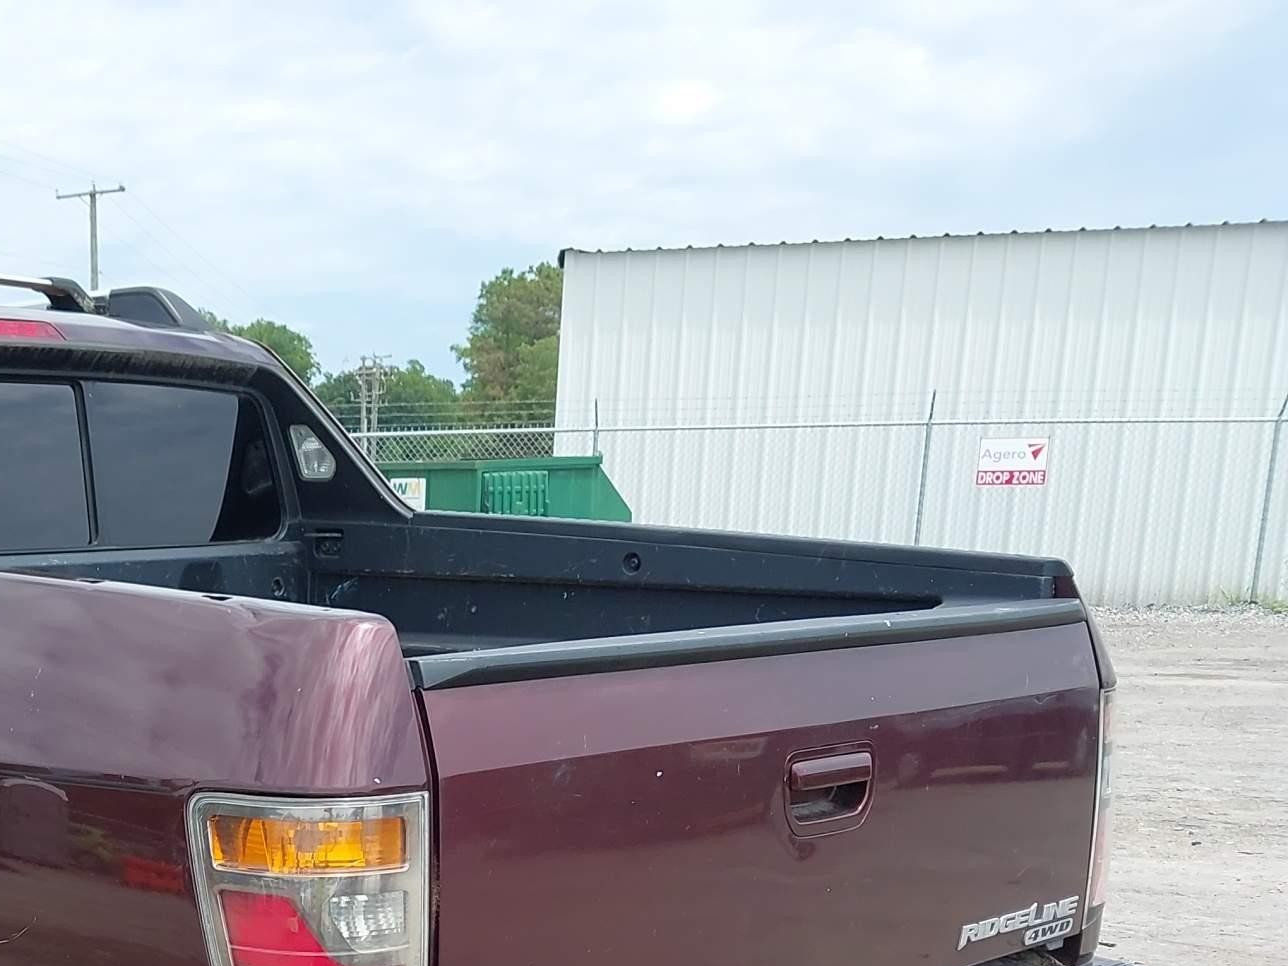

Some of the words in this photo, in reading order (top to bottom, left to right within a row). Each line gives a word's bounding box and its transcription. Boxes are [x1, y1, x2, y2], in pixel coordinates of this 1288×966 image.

[982, 449, 1026, 462] Agero
[977, 471, 1010, 484] DROP
[1012, 471, 1045, 484] ZONE
[956, 895, 1079, 951] RIDGELINE
[1028, 921, 1070, 941] 4WD
